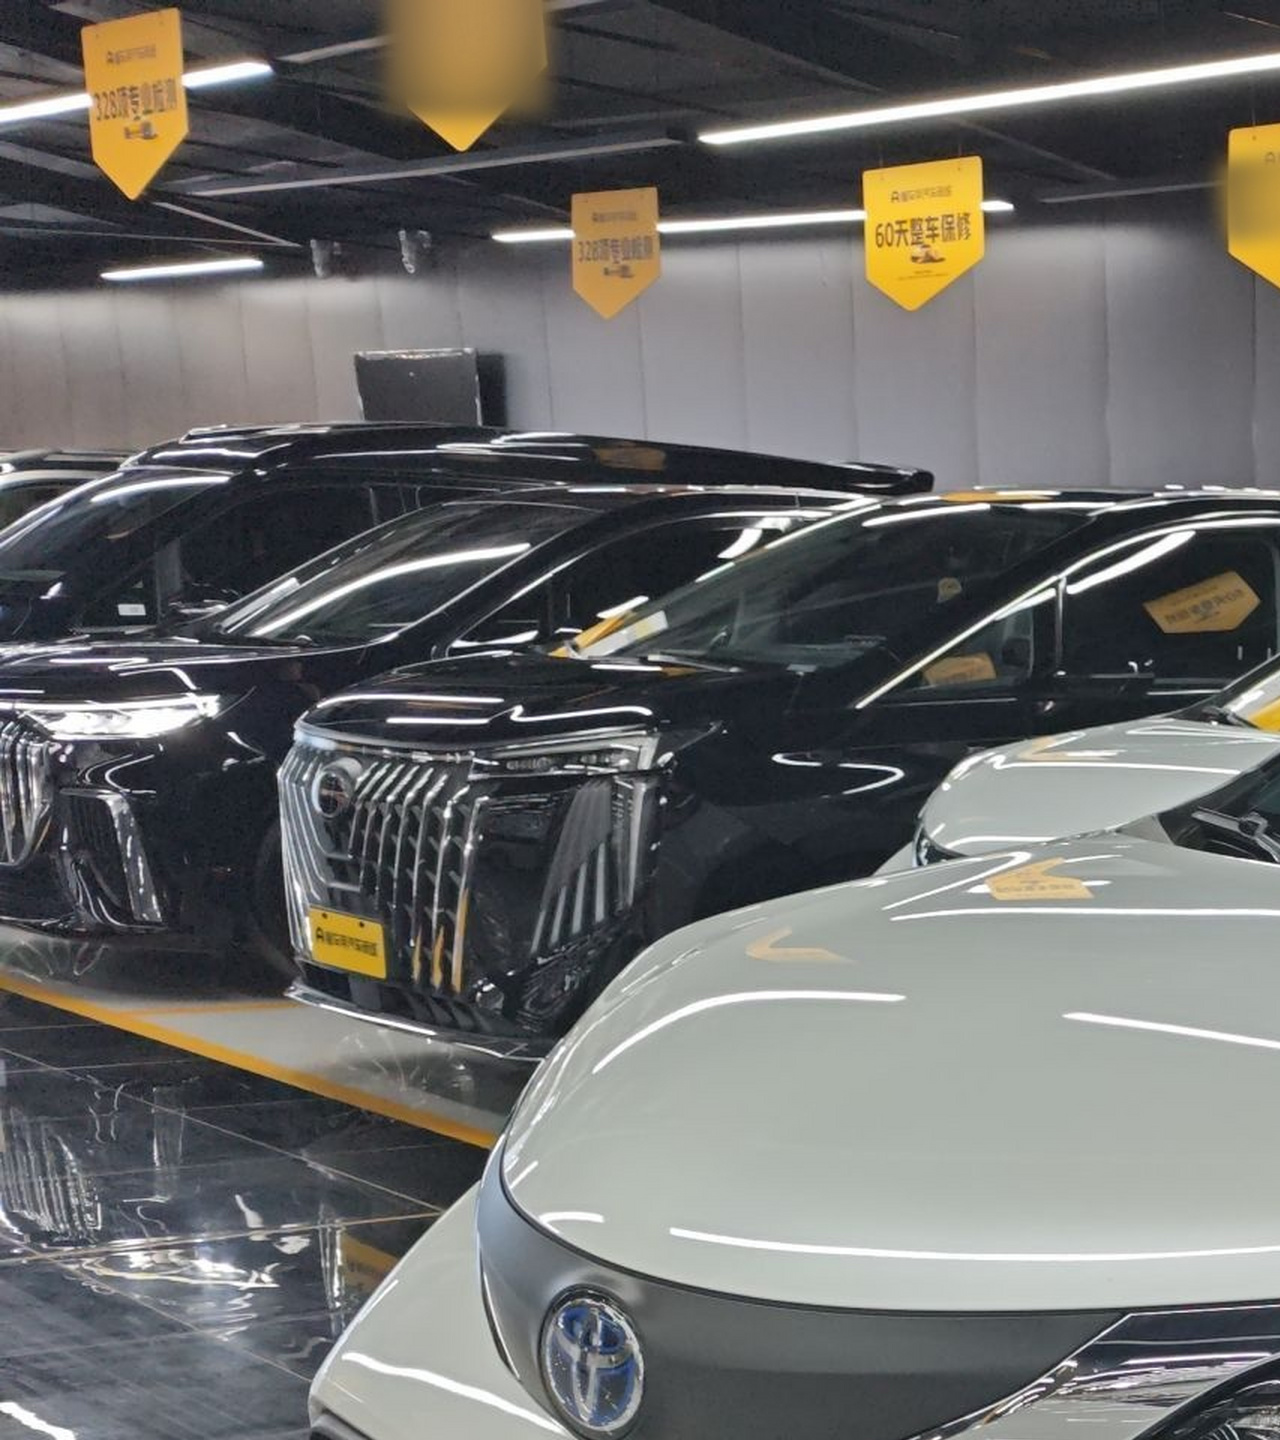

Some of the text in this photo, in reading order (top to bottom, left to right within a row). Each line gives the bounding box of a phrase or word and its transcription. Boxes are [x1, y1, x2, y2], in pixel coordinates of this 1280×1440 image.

[875, 212, 972, 248] 60天整车保修
